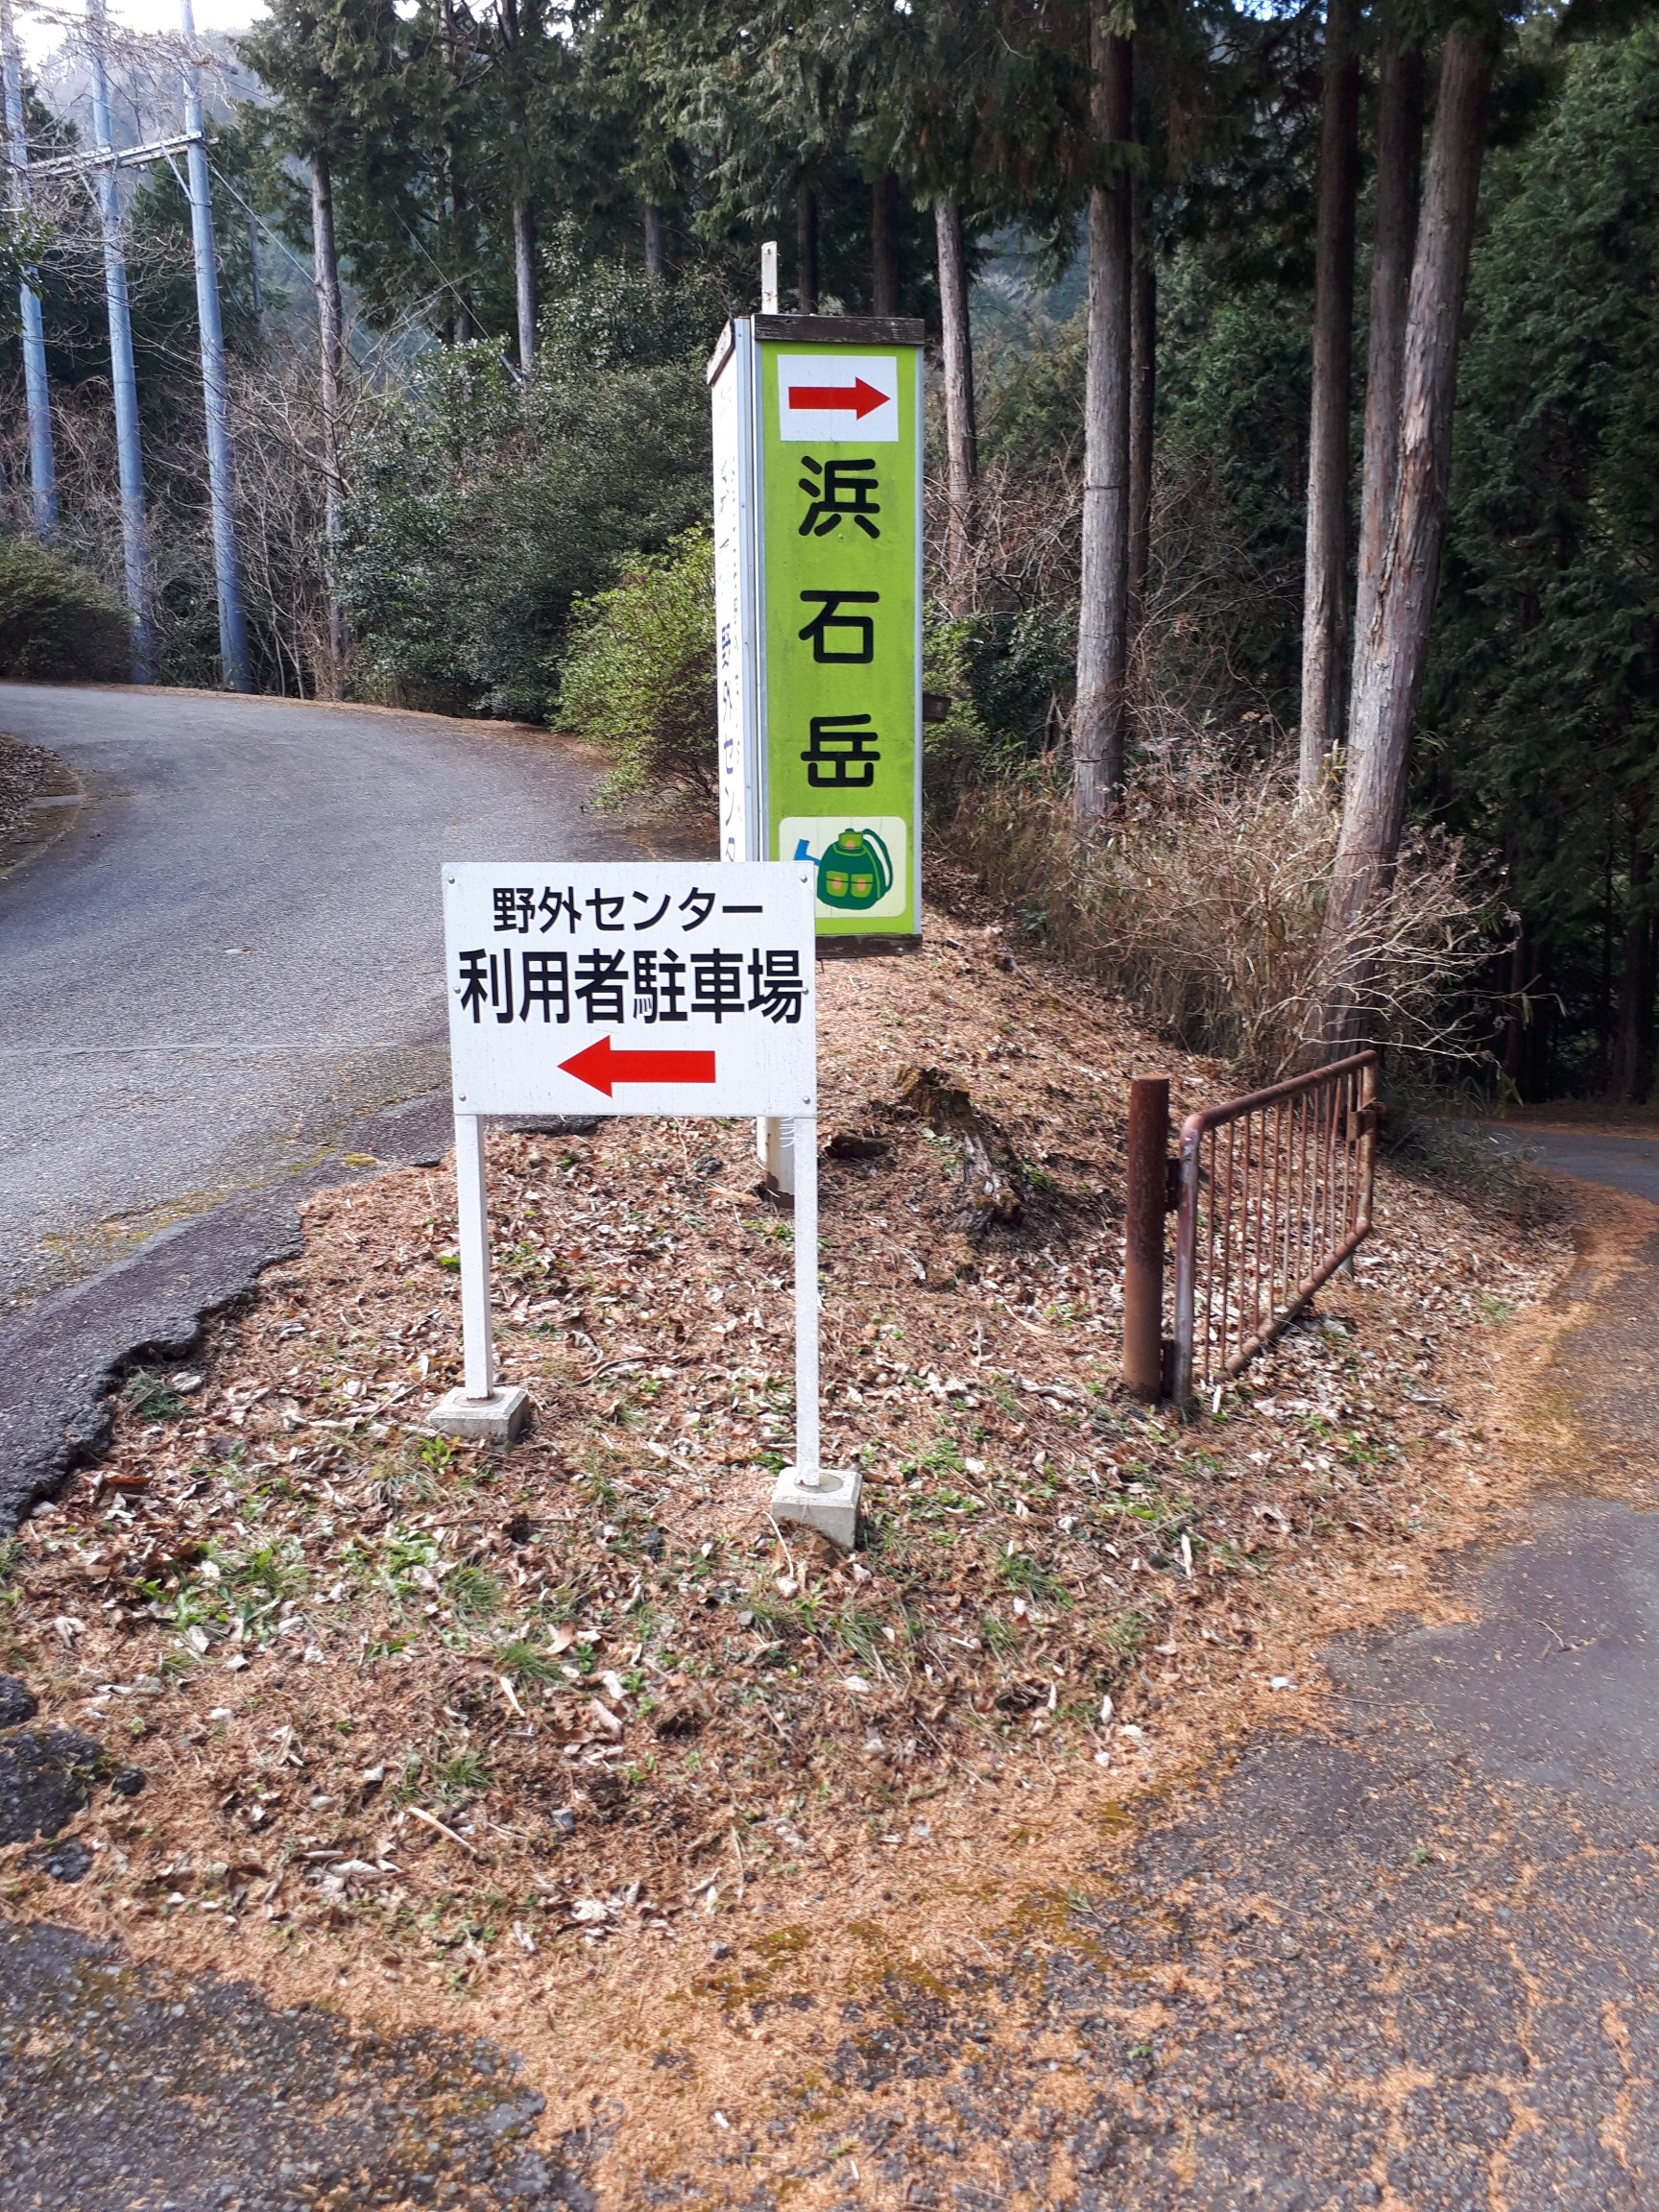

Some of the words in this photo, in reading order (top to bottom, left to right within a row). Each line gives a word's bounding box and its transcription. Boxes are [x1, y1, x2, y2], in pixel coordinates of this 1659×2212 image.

[798, 455, 881, 788] 浜石岳
[493, 886, 763, 934] 野外センター
[457, 948, 805, 1024] 利用者駐車場
